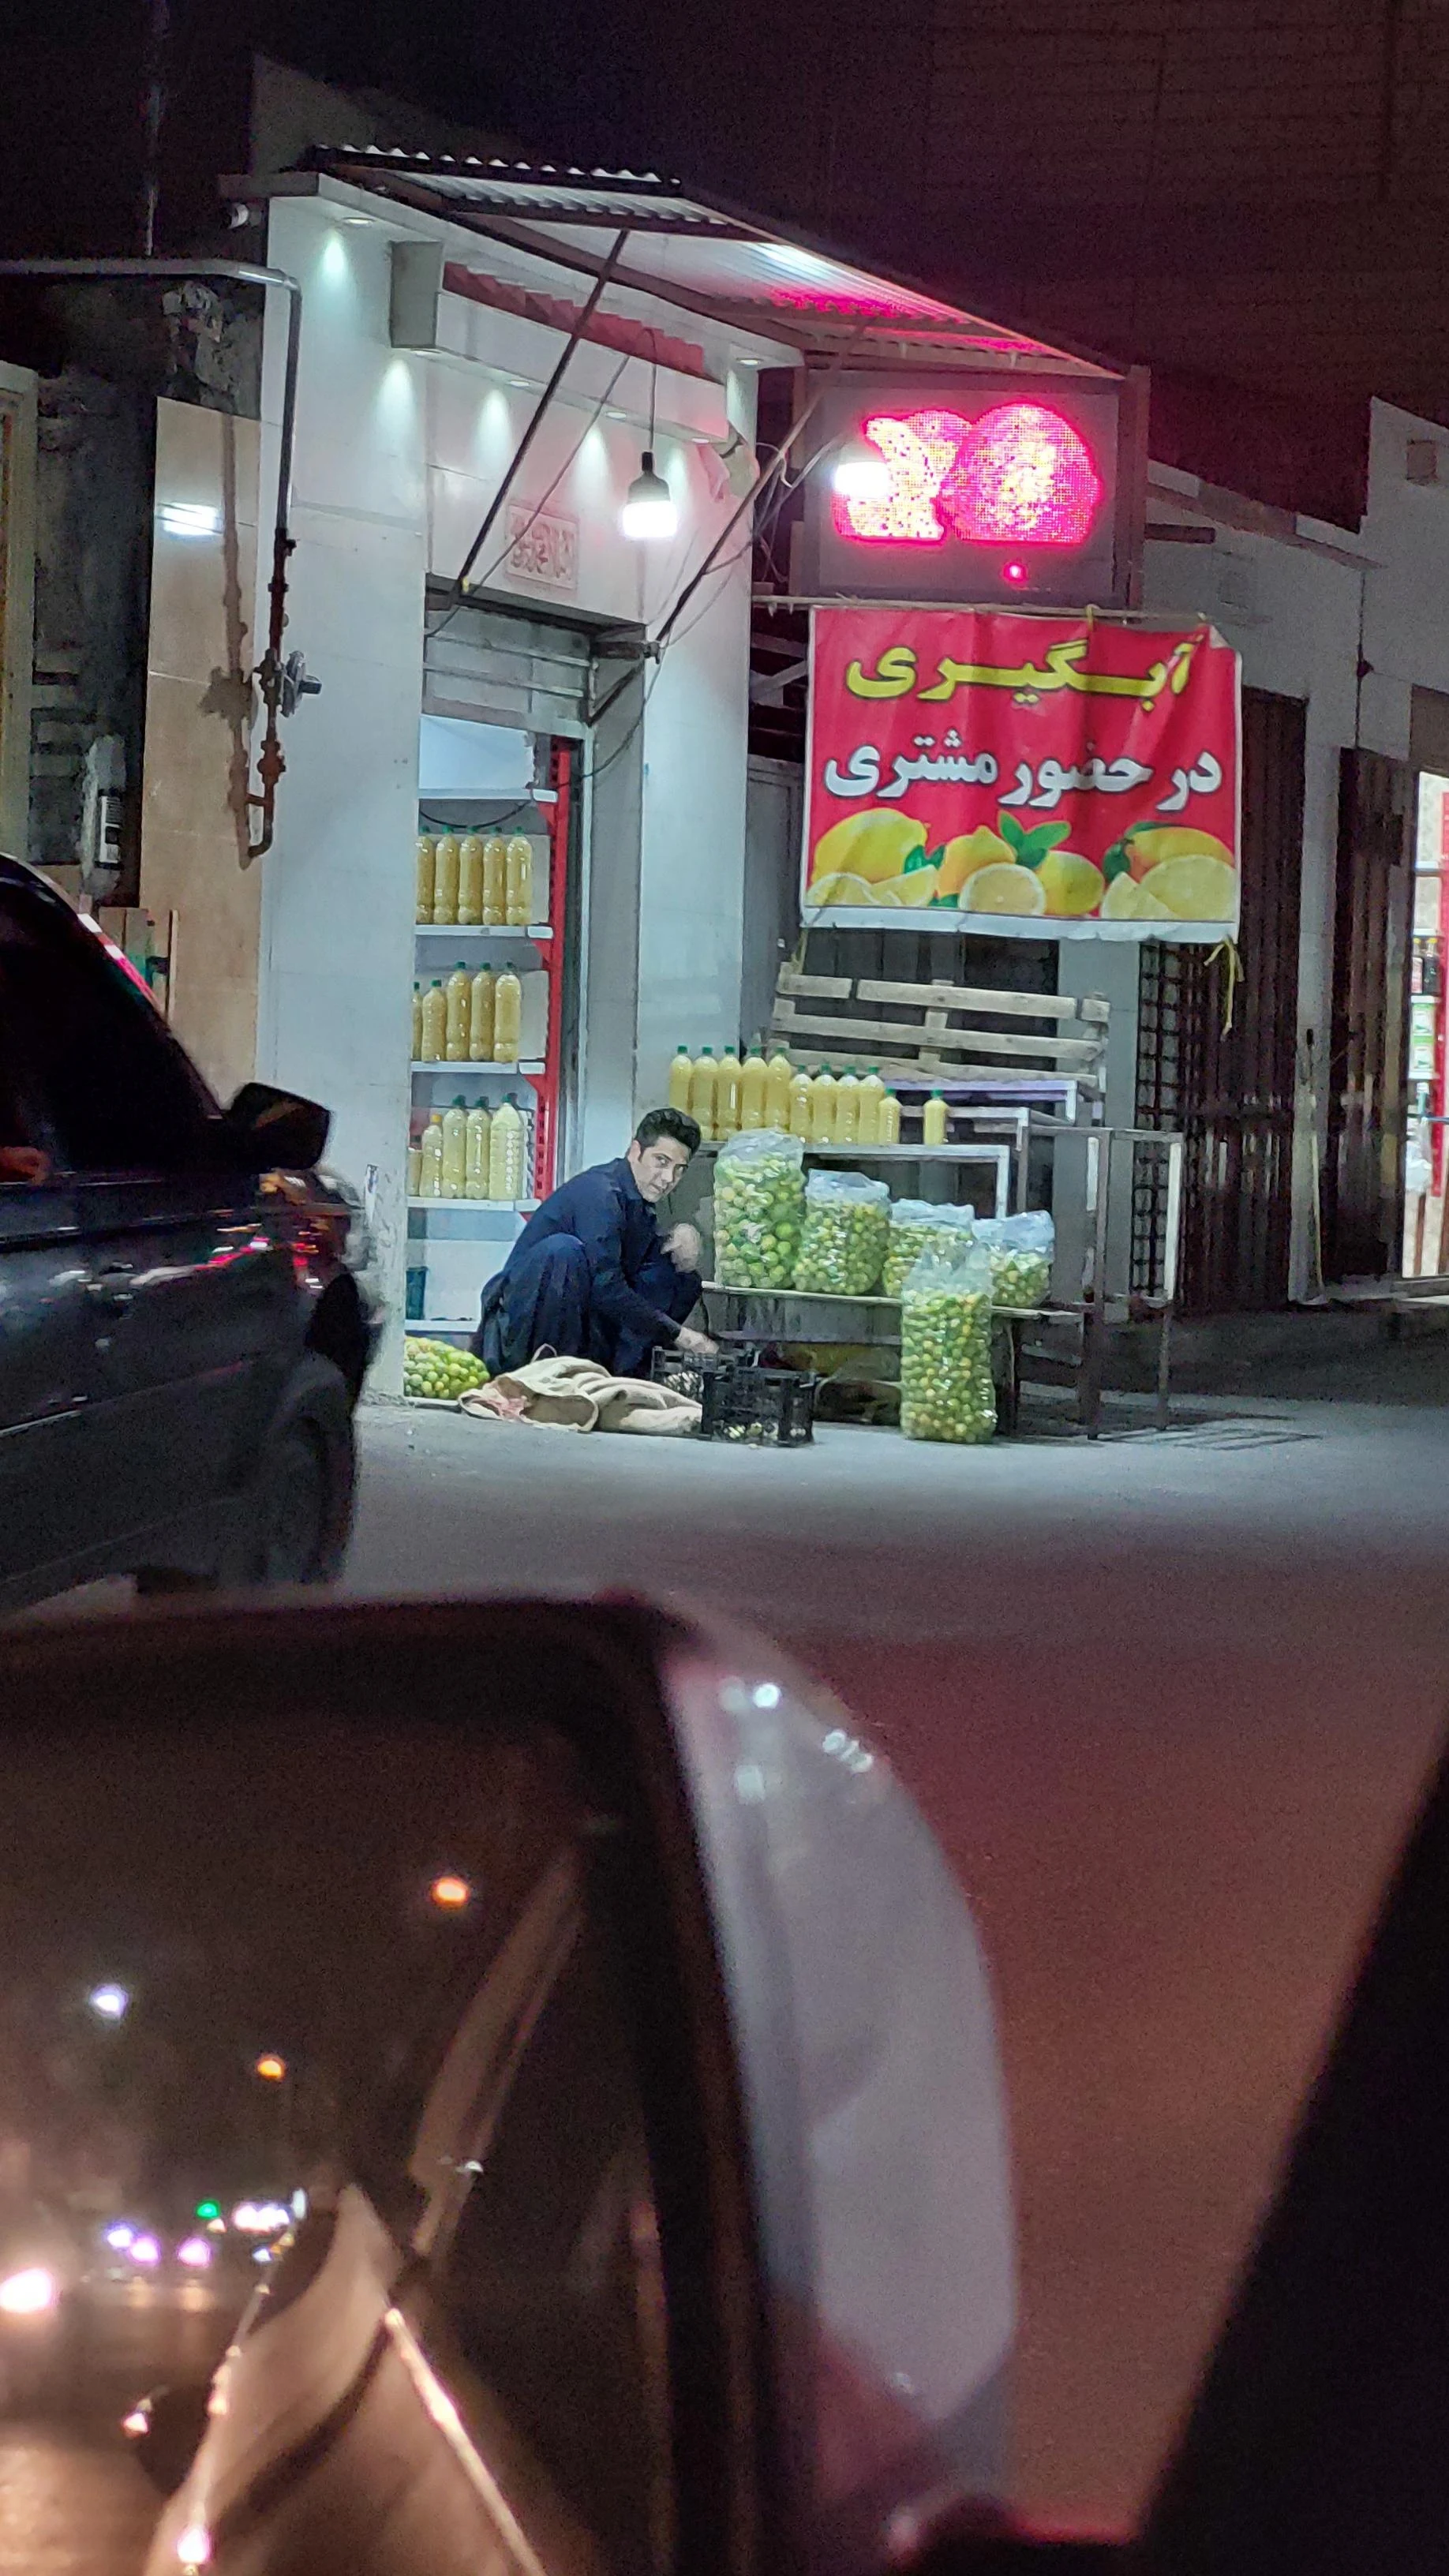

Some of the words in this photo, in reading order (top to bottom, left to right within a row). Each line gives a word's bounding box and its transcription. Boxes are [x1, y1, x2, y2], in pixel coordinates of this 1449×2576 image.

[845, 634, 1205, 711] آبگیری
[824, 728, 998, 799] مشتری
[998, 743, 1154, 810] حضور
[1155, 750, 1222, 811] در
